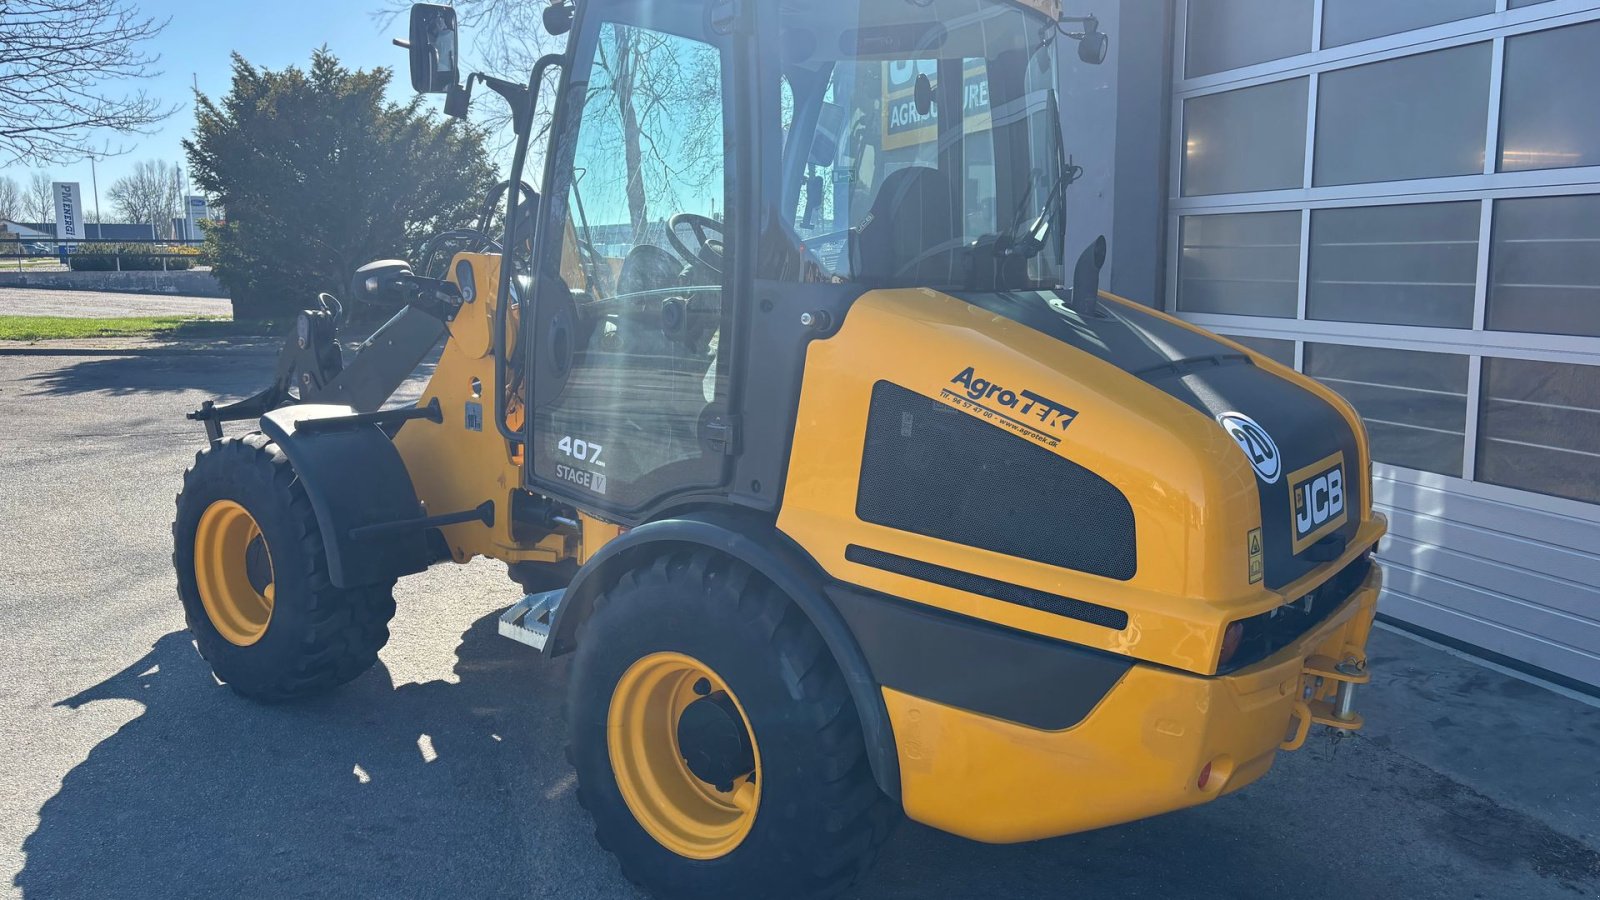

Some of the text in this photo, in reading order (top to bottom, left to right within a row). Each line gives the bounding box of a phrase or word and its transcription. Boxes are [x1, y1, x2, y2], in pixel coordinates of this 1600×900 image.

[952, 397, 961, 405] 96
[962, 401, 971, 409] 57
[972, 406, 982, 414] 47
[983, 411, 993, 419] 00
[999, 418, 1058, 448] www.agrotek.dk
[558, 435, 602, 464] 407
[1231, 424, 1274, 465] 20
[556, 464, 591, 488] STAGE
[1297, 469, 1343, 533] JCB
